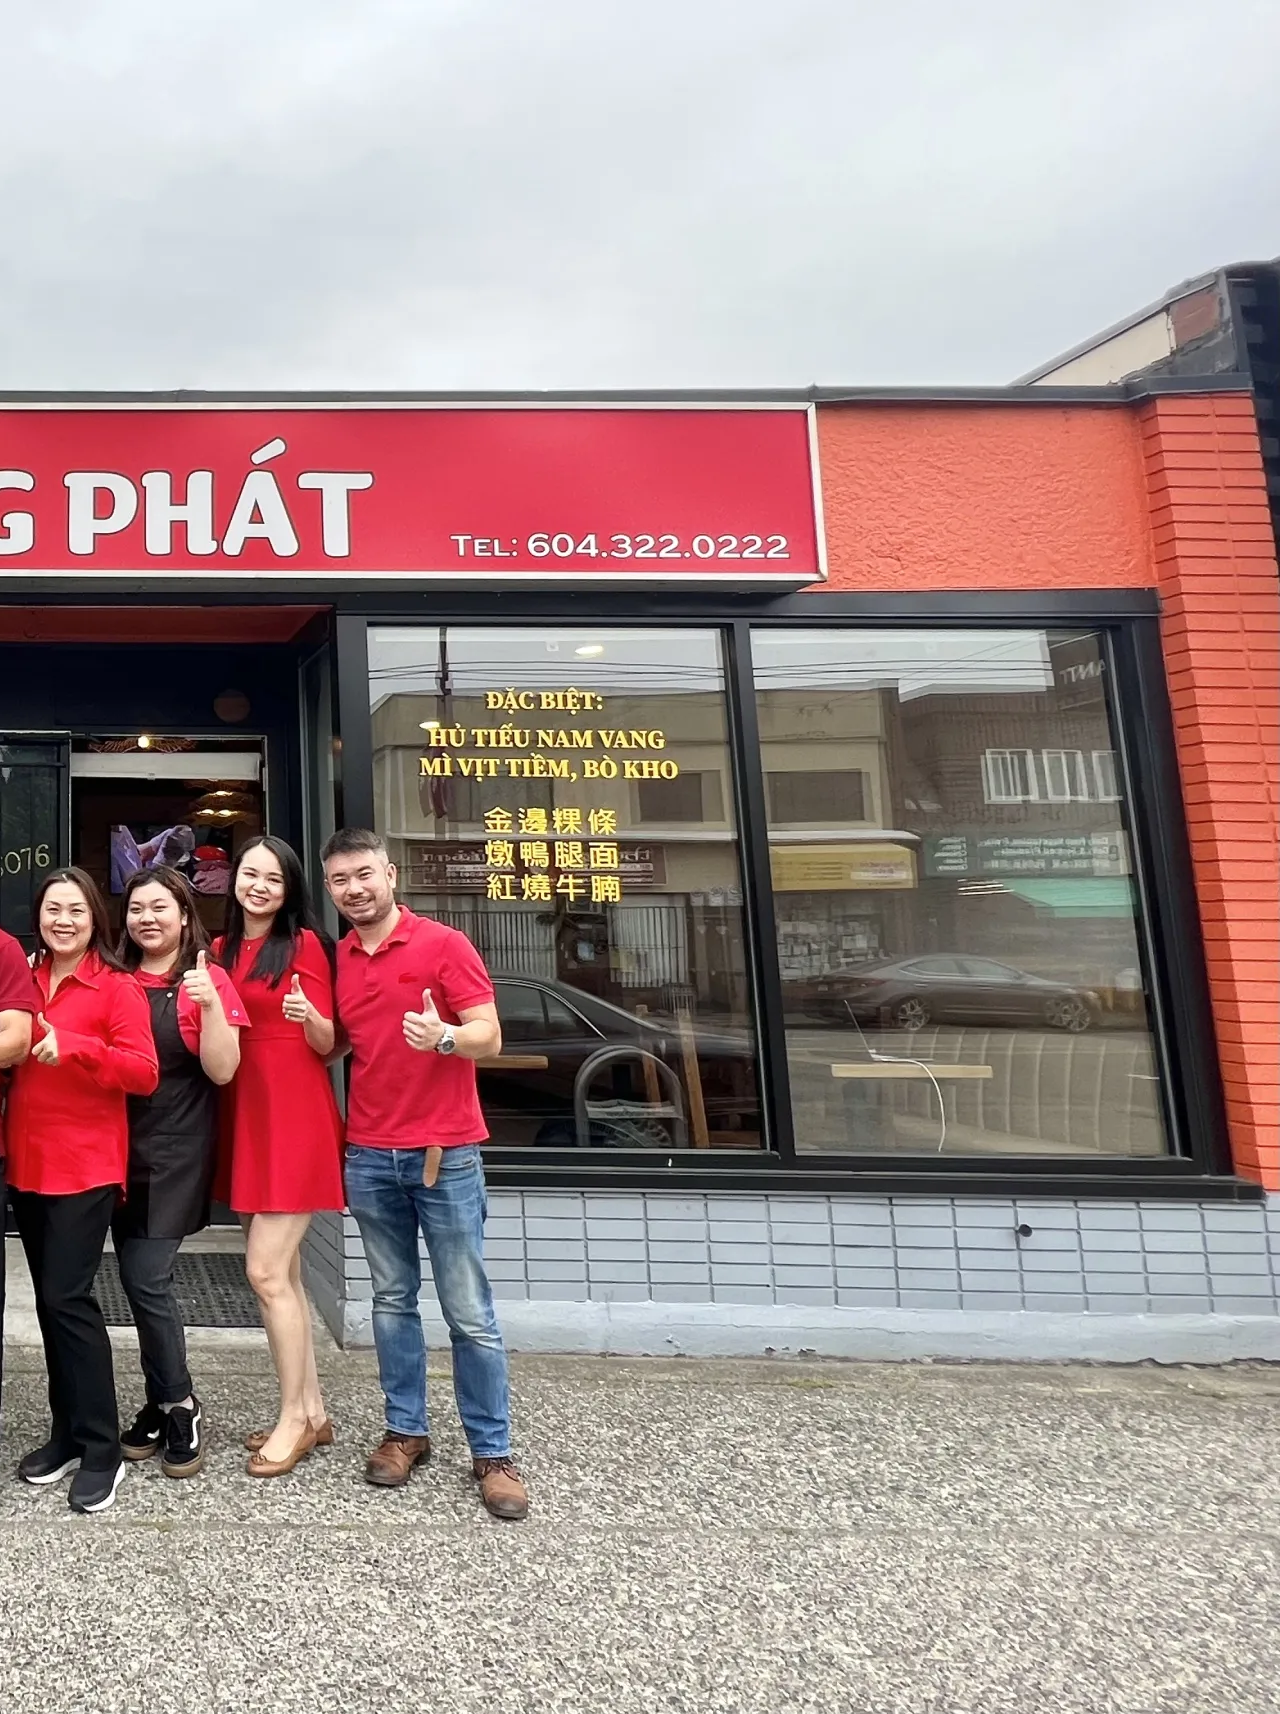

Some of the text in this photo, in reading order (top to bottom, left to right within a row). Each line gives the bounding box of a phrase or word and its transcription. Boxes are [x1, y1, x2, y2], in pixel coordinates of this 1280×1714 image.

[63, 437, 374, 557] PHÁT
[450, 533, 791, 559] TEL: 604.322.0222
[486, 686, 604, 714] ĐẶC BIỆT:
[428, 722, 666, 750] HỦ TIẾU NAM VANG
[419, 752, 679, 783] MÌ VỊT TIỀM, BÒ KHO
[483, 806, 617, 836] 金邊粿條
[484, 839, 620, 869] 燉鴨腿面
[486, 872, 621, 902] 紅燒牛腩
